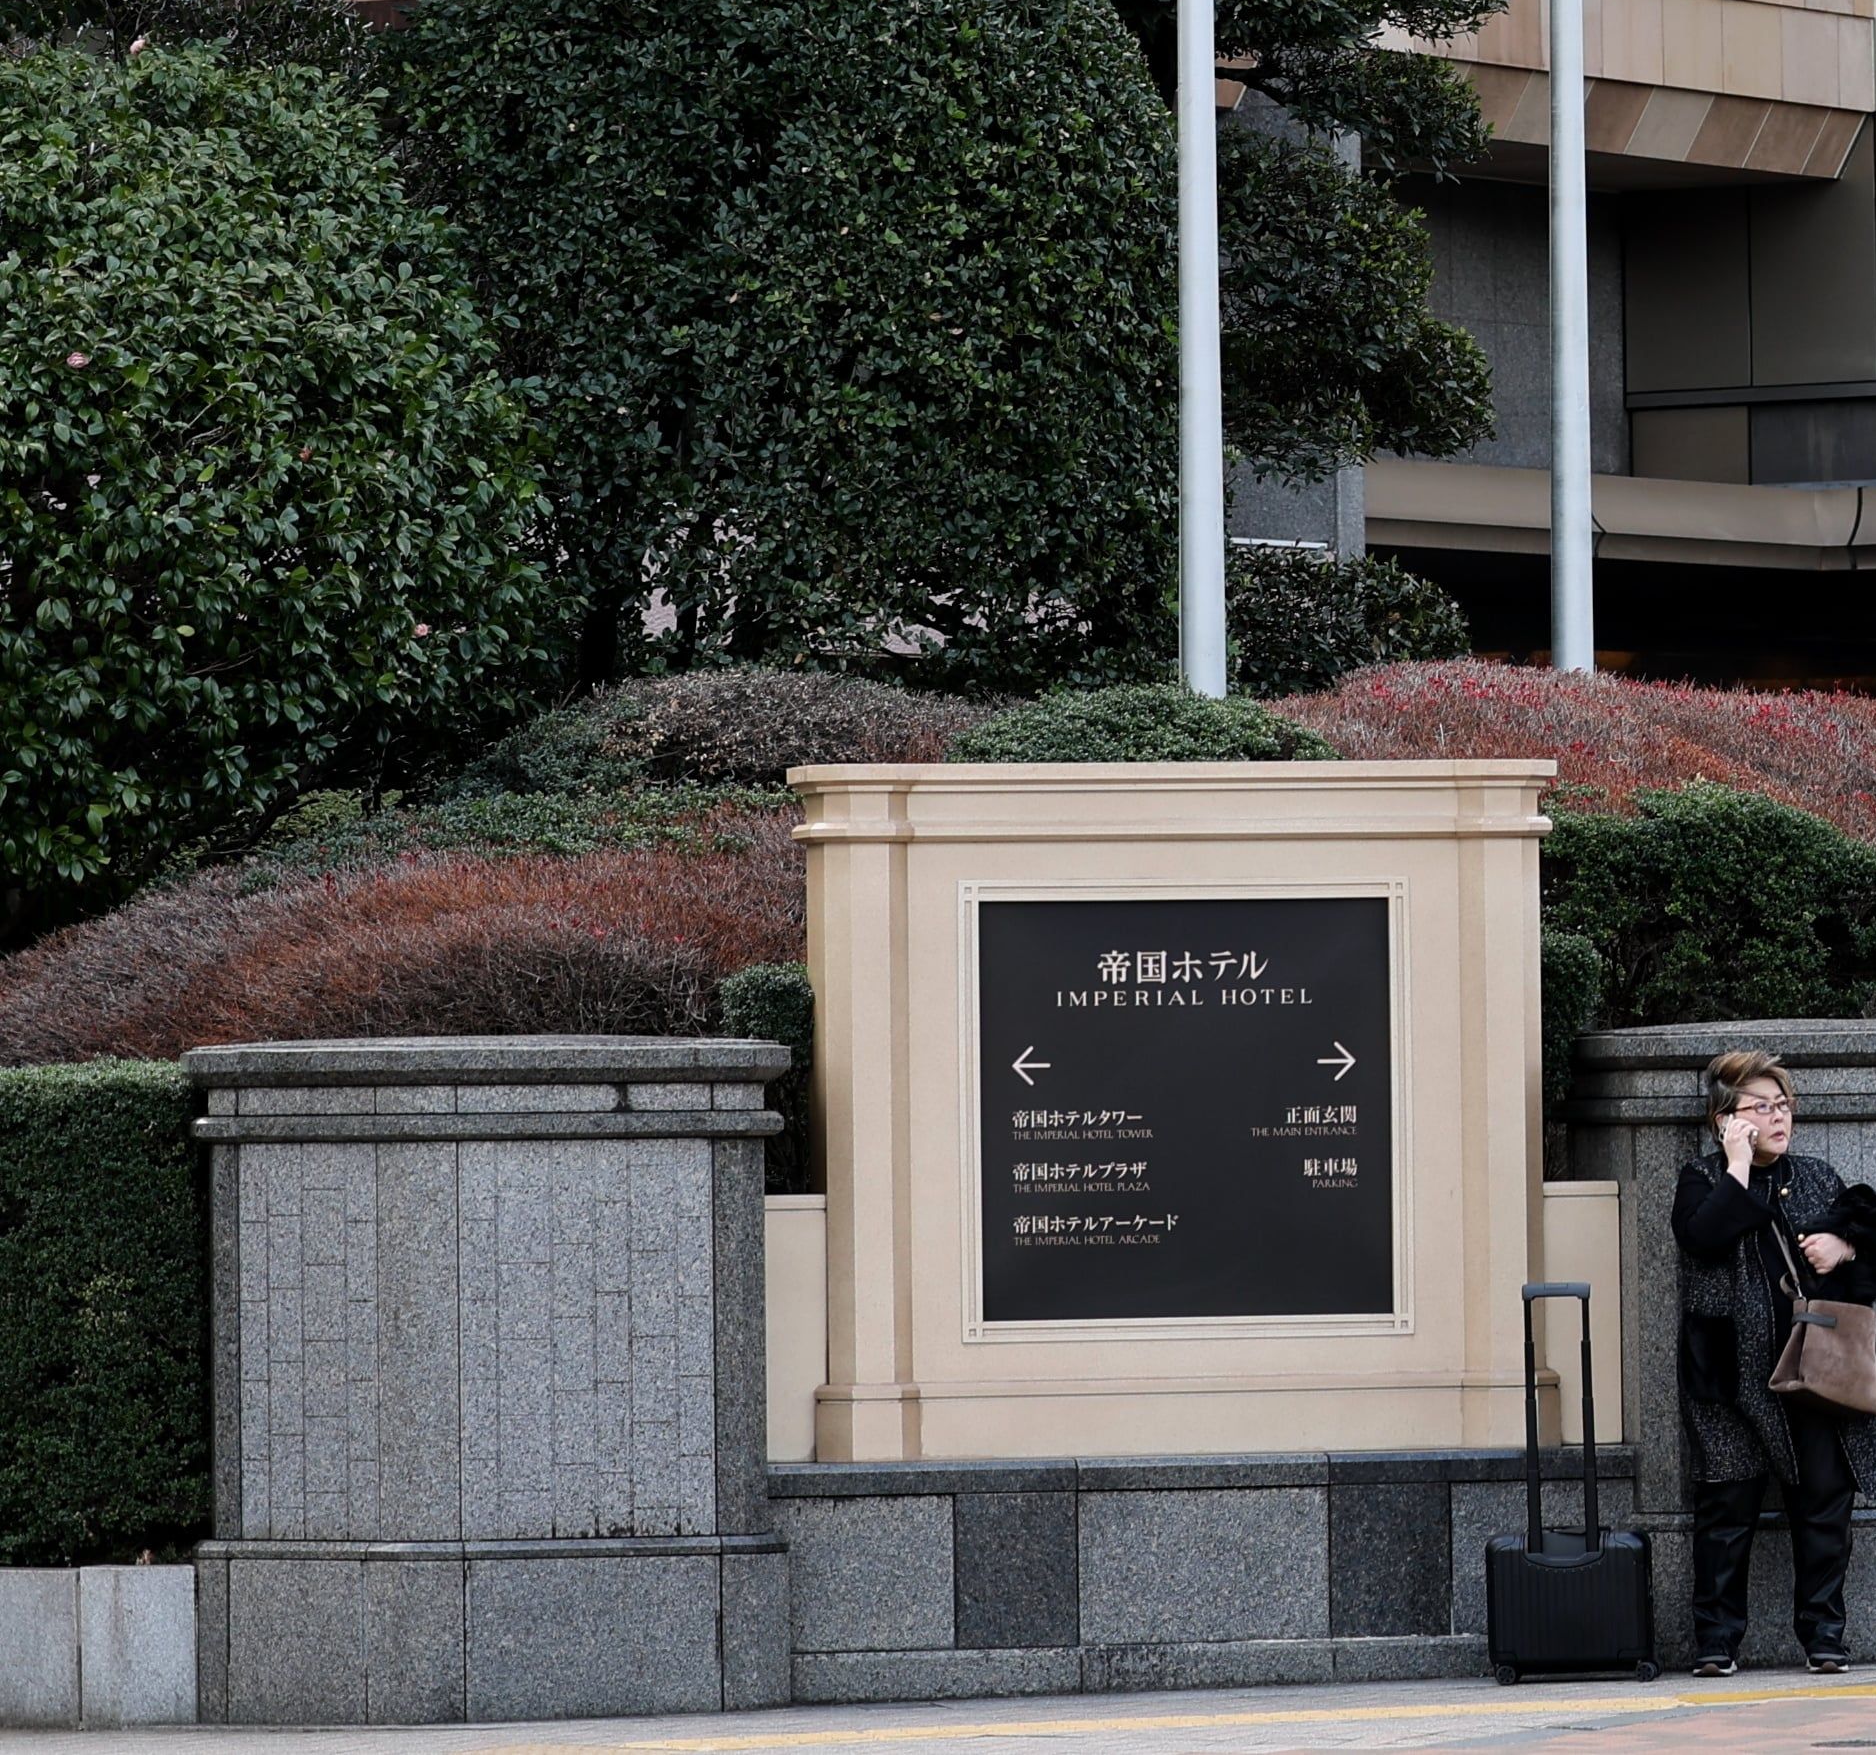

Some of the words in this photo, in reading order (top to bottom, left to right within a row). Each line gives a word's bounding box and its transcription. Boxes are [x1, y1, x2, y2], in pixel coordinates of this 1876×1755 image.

[1097, 950, 1269, 985] 帝国ホテル
[1056, 989, 1204, 1007] IMPERIAL
[1220, 988, 1313, 1006] HOTEL
[1012, 1110, 1143, 1129] 帝国ホテルタワー
[1285, 1105, 1357, 1124] 正面玄関
[1012, 1131, 1031, 1140] THE
[1034, 1130, 1080, 1140] IMPERIAL
[1083, 1129, 1114, 1139] HOTEL
[1117, 1129, 1153, 1139] TOWER
[1250, 1127, 1269, 1137] THE
[1272, 1127, 1301, 1136] MAIN
[1304, 1126, 1358, 1136] ENTRANCE
[1012, 1162, 1148, 1182] 帝国ホテルプラザ
[1303, 1157, 1358, 1177] 駐車場
[1013, 1184, 1032, 1193] THE
[1034, 1183, 1080, 1193] IMPERIAL
[1083, 1182, 1115, 1192] HOTEL
[1117, 1182, 1150, 1191] PLAZA
[1312, 1178, 1358, 1188] PARKING
[1013, 1214, 1179, 1235] 帝国ホテルアーケード
[1014, 1237, 1032, 1246] THE
[1035, 1236, 1081, 1246] IMPERIAL
[1084, 1235, 1115, 1245] HOTEL
[1118, 1234, 1161, 1244] ARCADE
